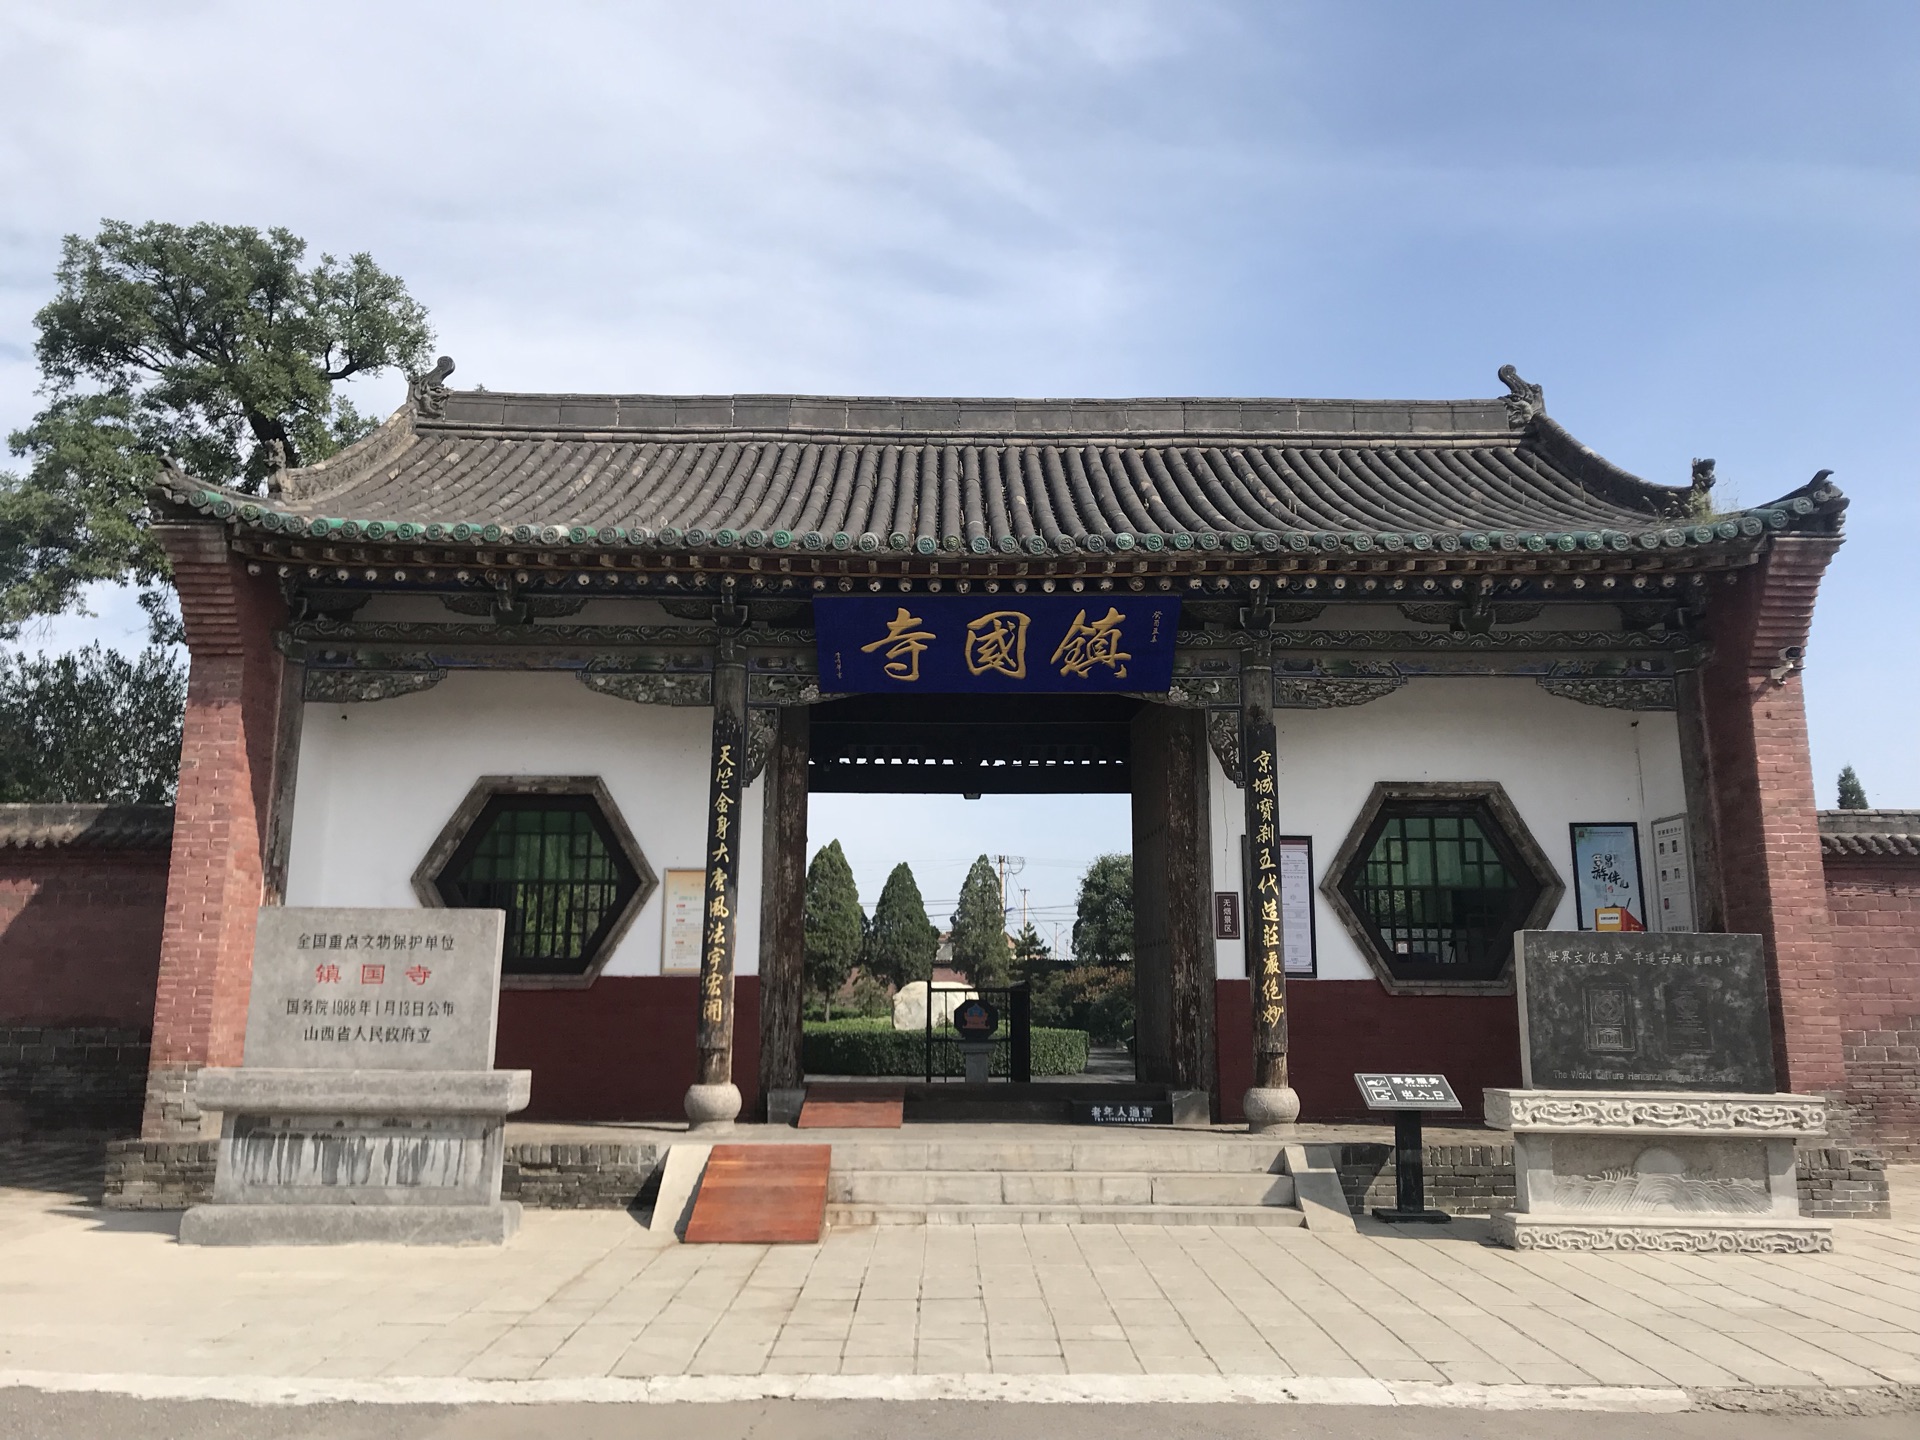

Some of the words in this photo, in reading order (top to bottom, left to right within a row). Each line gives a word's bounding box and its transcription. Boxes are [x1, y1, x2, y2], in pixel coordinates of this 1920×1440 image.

[1223, 898, 1232, 933] 无烟景区
[297, 932, 455, 951] 全国重点文物保护单位
[1548, 950, 1624, 965] 世界文化遗产
[315, 963, 432, 985] 镇国寺
[286, 999, 454, 1016] 国务院1988年1月13日公布
[303, 1026, 432, 1044] 山西省人民政府立
[1553, 1070, 1568, 1079] The
[1571, 1070, 1592, 1080] World
[1091, 1106, 1153, 1118] 老年人通道
